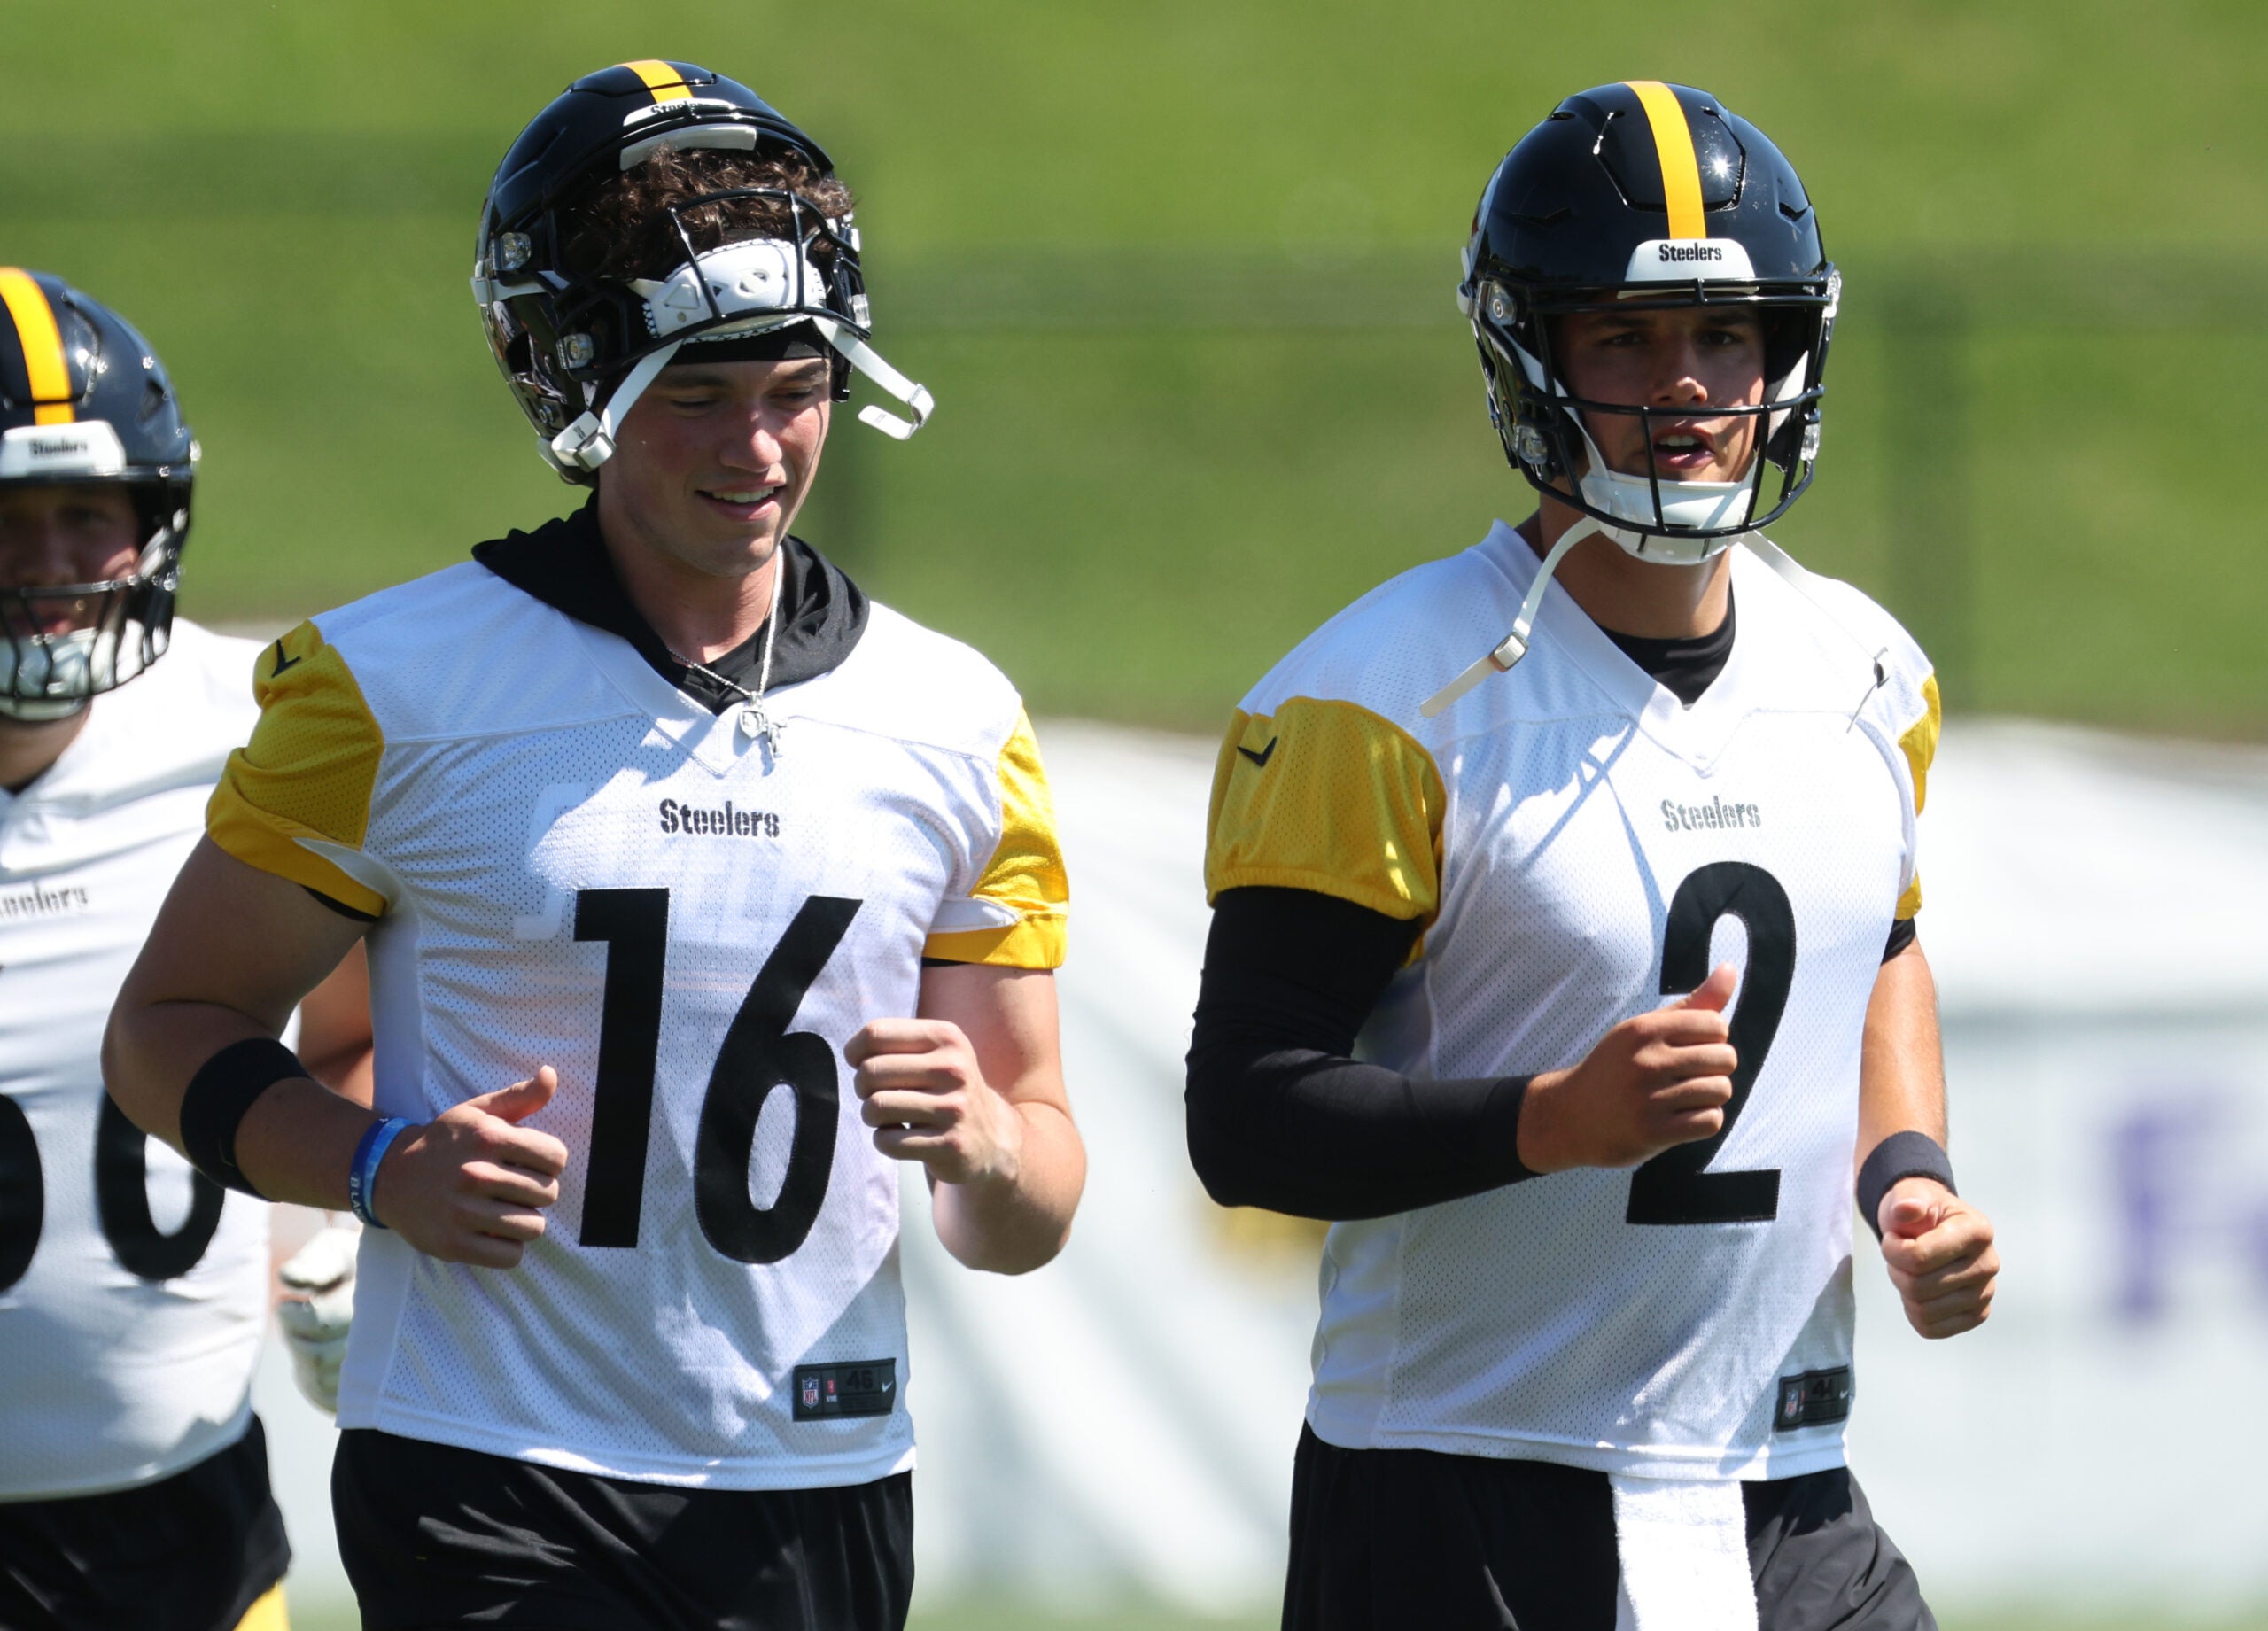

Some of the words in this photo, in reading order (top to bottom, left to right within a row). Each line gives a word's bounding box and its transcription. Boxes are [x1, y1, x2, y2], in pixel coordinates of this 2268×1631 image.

[1658, 243, 1722, 262] Steelers
[659, 799, 780, 838] Steelers
[1660, 795, 1761, 832] Steelers
[1626, 861, 1796, 1226] 2
[574, 888, 864, 1265] 16
